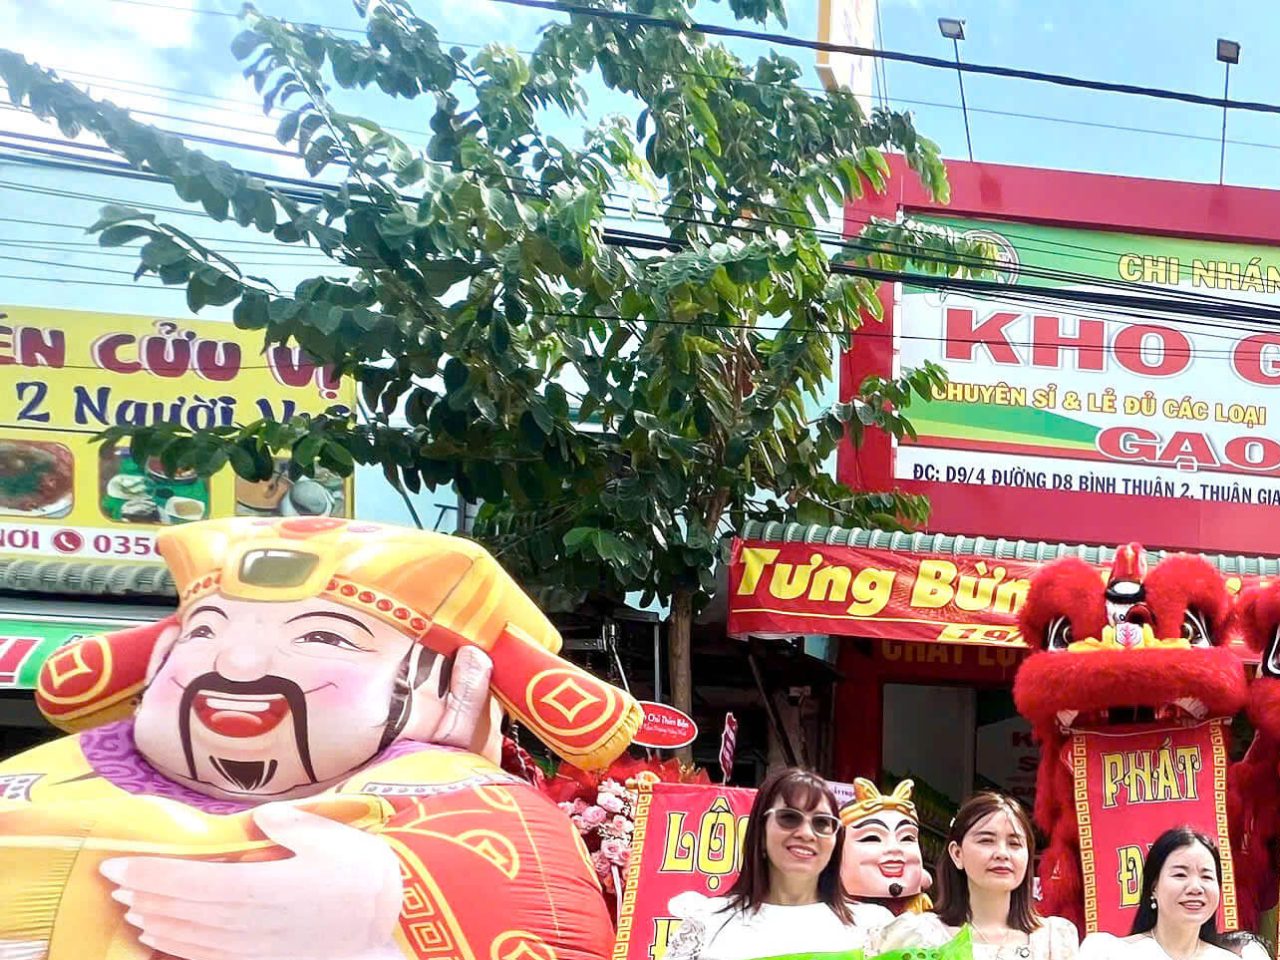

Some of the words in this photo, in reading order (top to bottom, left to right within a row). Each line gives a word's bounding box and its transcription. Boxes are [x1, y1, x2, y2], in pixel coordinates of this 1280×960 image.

[1119, 252, 1181, 289] CHI
[90, 318, 242, 382] CỬU
[942, 307, 1193, 377] KHO
[16, 381, 50, 422] 2
[931, 381, 1027, 407] CHUYÊN
[1032, 383, 1056, 409] SỈ
[1063, 391, 1081, 411] &
[1087, 387, 1116, 413] LẺ
[1125, 391, 1157, 417] ĐỦ
[1162, 395, 1209, 421] CÁC
[1214, 403, 1267, 429] LOẠI
[913, 463, 940, 481] ĐC:
[946, 465, 986, 485] D9/4
[992, 466, 1047, 488] ĐƯỜNG
[1052, 474, 1073, 490] D8
[1079, 473, 1117, 495] BÌNH
[0, 528, 40, 550] ƠI
[737, 547, 897, 616] Tưng
[910, 559, 1031, 614] Bừn
[957, 628, 1022, 643] 19/
[1101, 737, 1202, 809] PHÁT
[660, 797, 751, 890] LỘ
